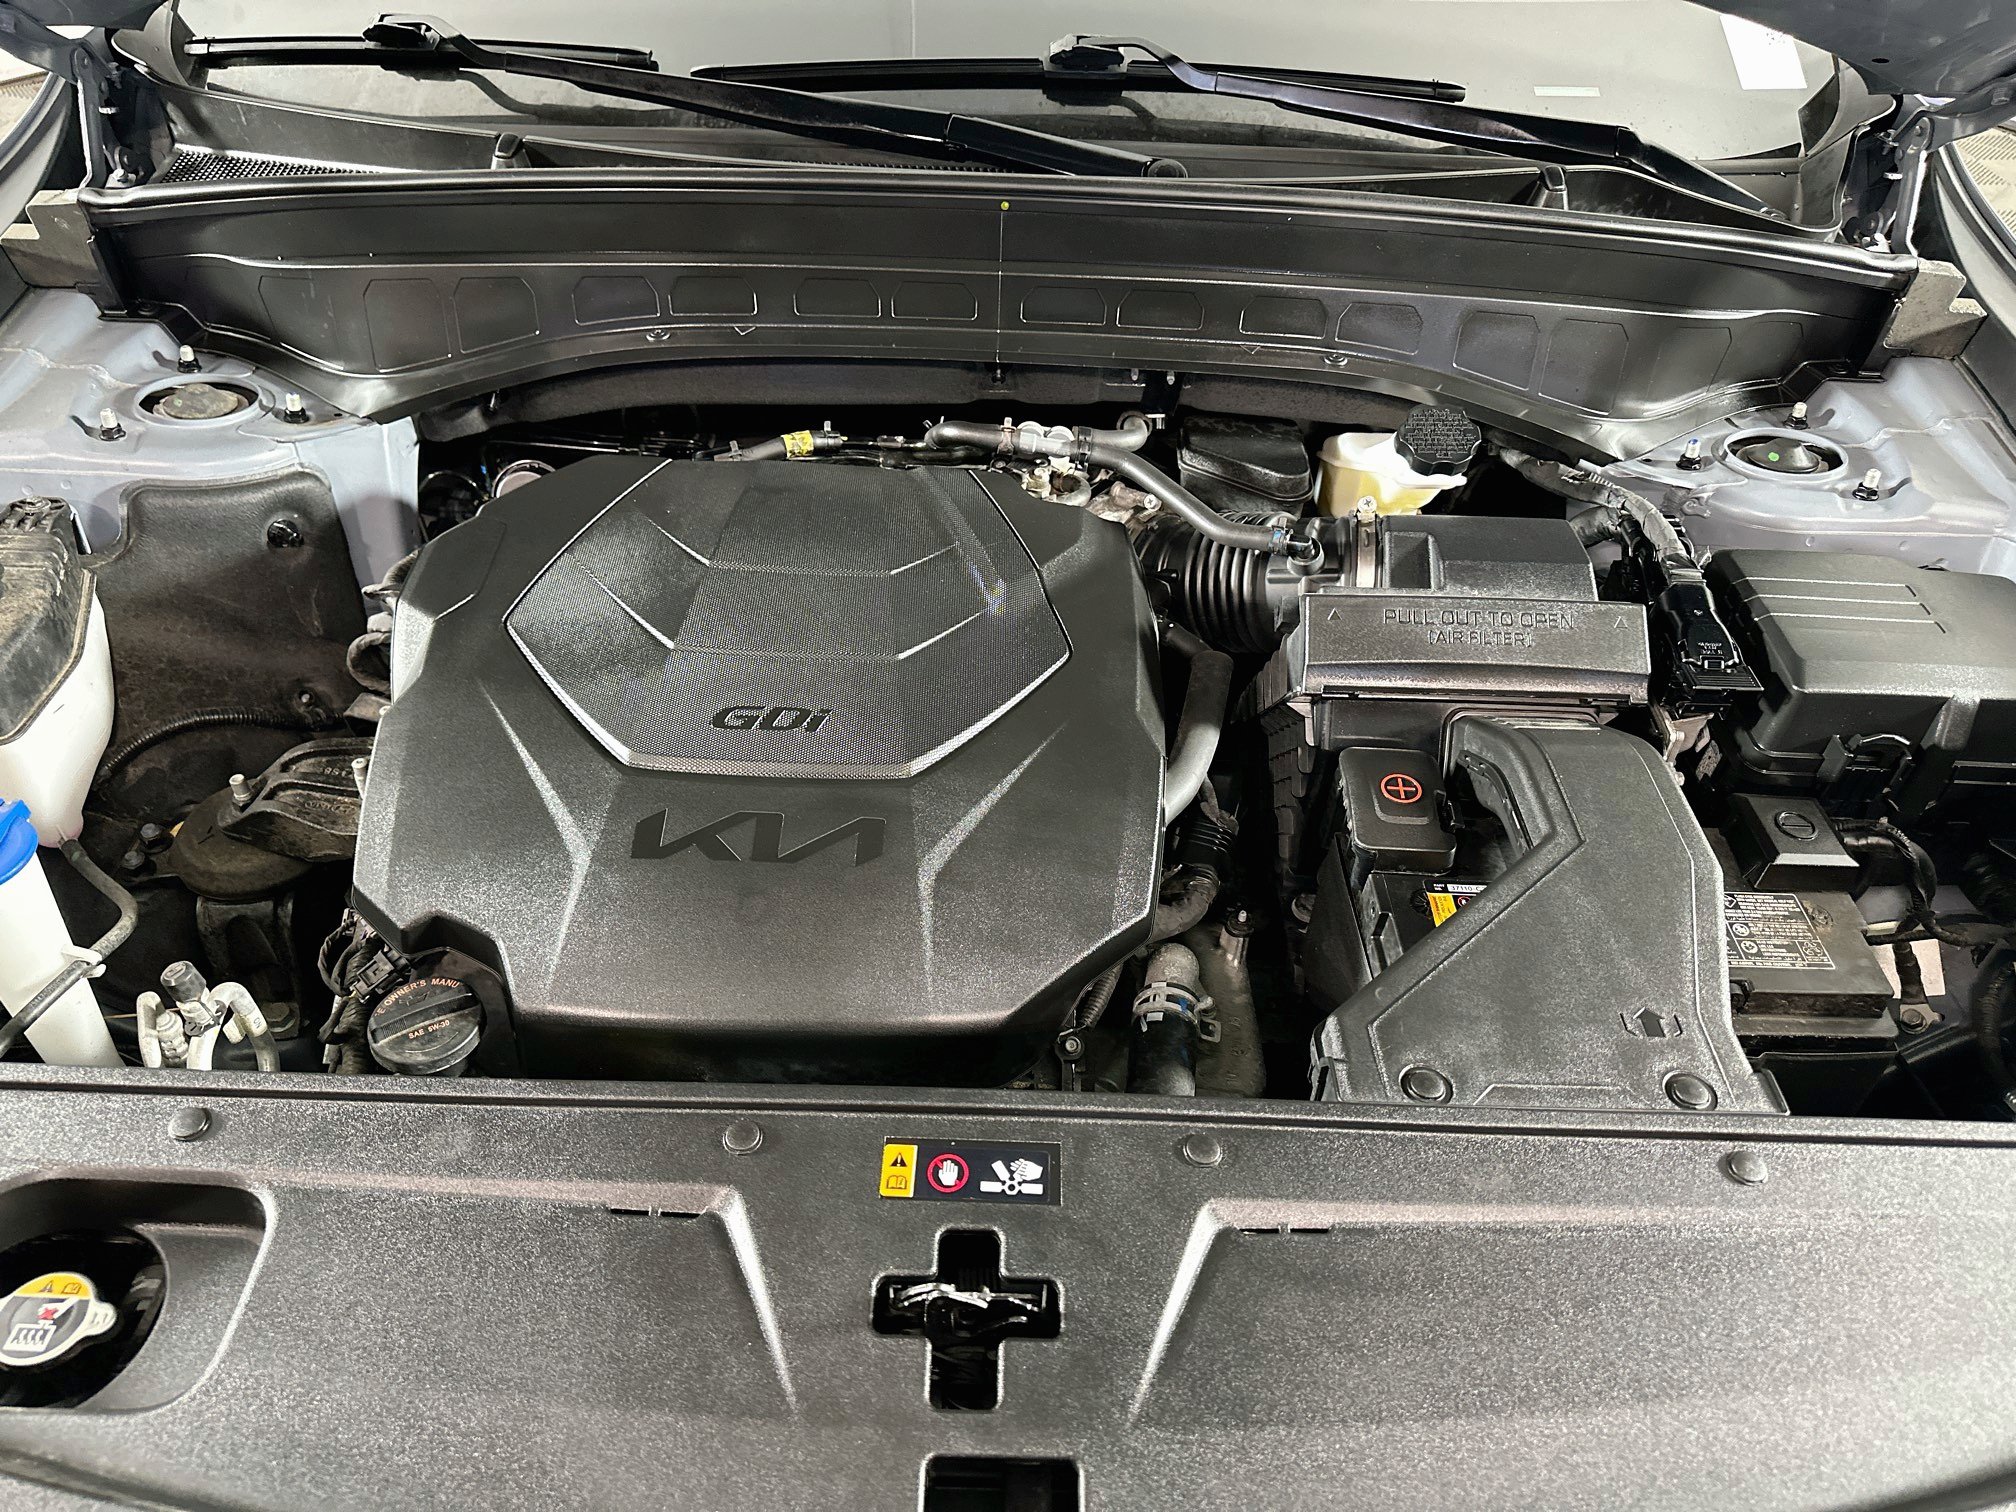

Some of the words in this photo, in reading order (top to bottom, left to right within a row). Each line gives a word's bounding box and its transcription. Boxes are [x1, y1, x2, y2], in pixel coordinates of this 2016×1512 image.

[1383, 608, 1435, 625] PULL
[1441, 610, 1481, 626] OUT
[1488, 611, 1514, 627] TO
[1520, 612, 1574, 629] OPEN
[710, 704, 833, 733] GDi
[631, 808, 887, 868] KIA
[383, 979, 427, 1006] OWNER'S
[408, 1028, 425, 1039] SAE
[427, 1019, 450, 1033] 5W-30
